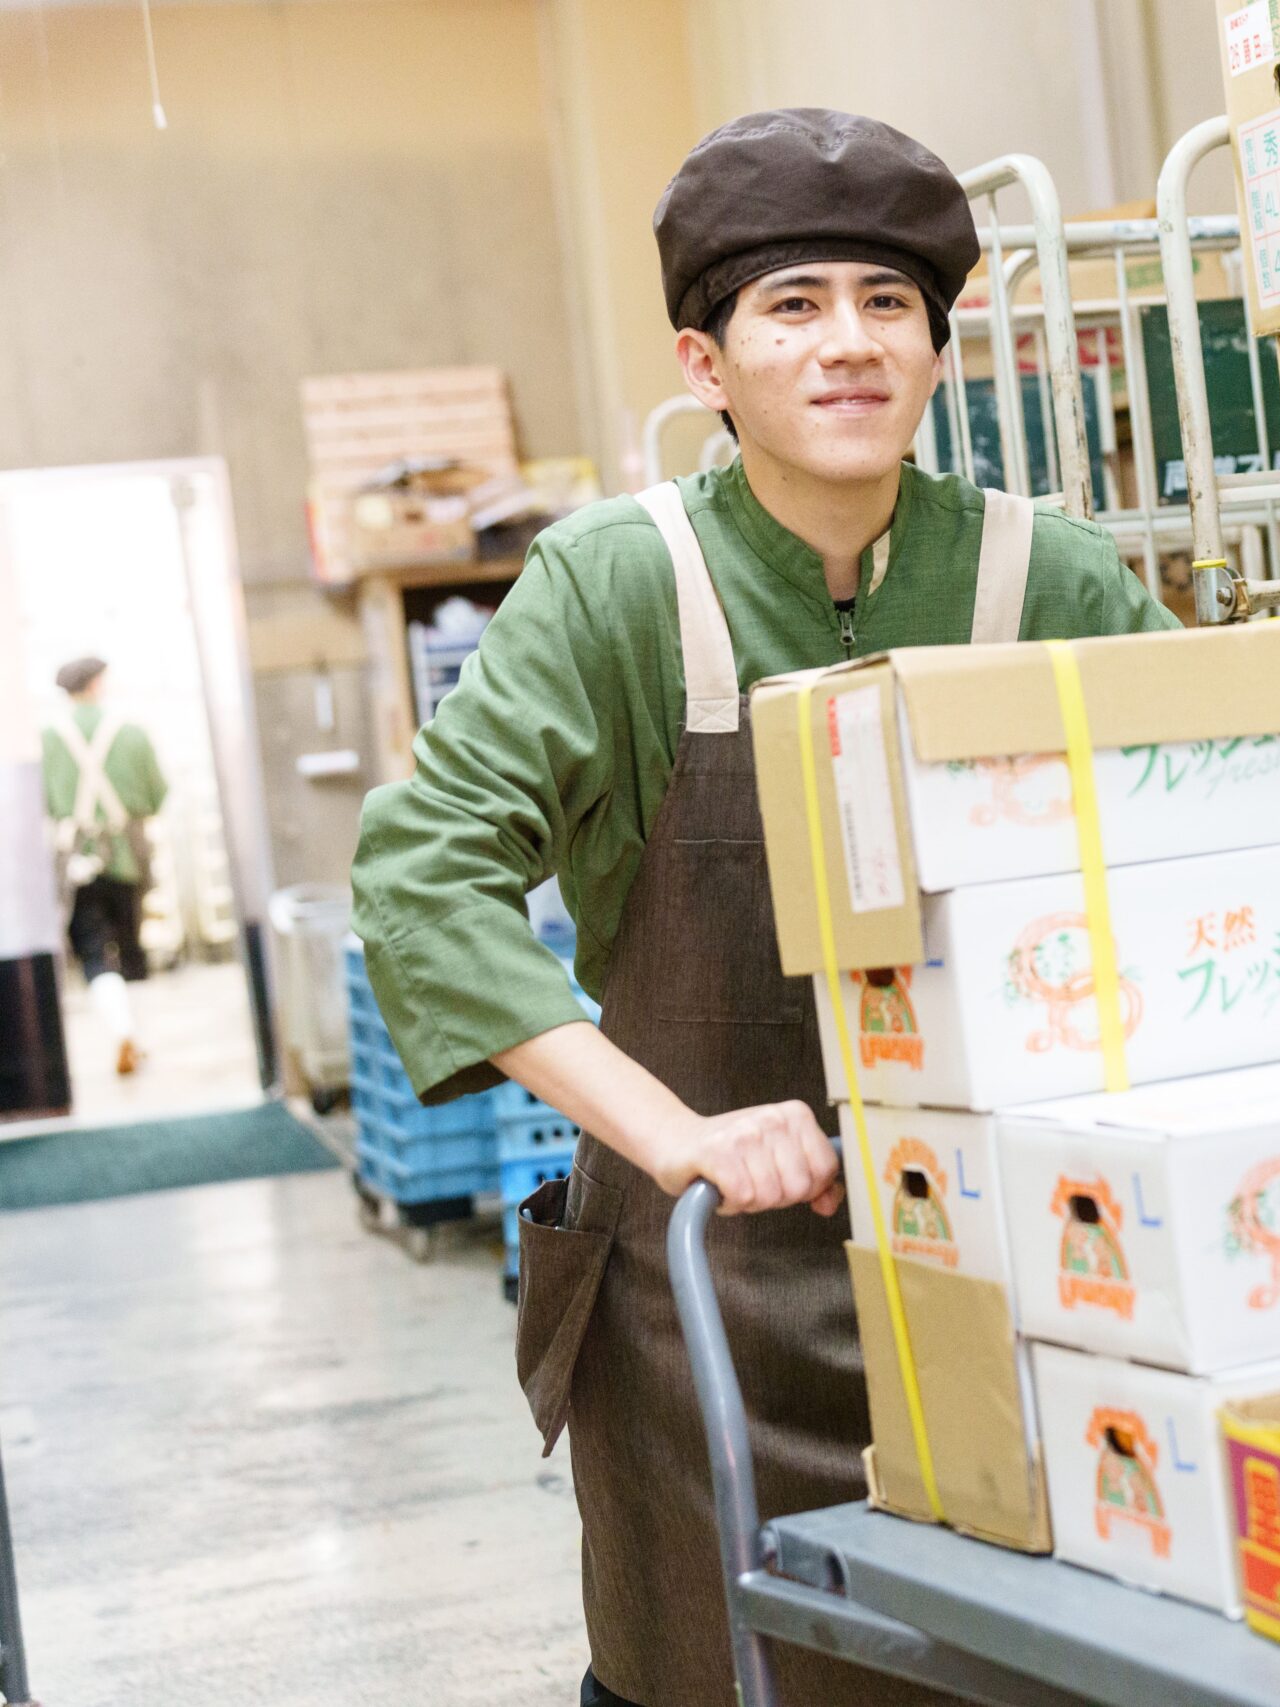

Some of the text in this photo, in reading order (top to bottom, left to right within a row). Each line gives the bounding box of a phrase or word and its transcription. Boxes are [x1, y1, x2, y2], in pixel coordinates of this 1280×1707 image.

[1263, 130, 1279, 167] 秀
[1265, 191, 1280, 218] 4L
[957, 1149, 980, 1198] L
[1132, 1173, 1162, 1227] L
[1167, 1417, 1197, 1472] L
